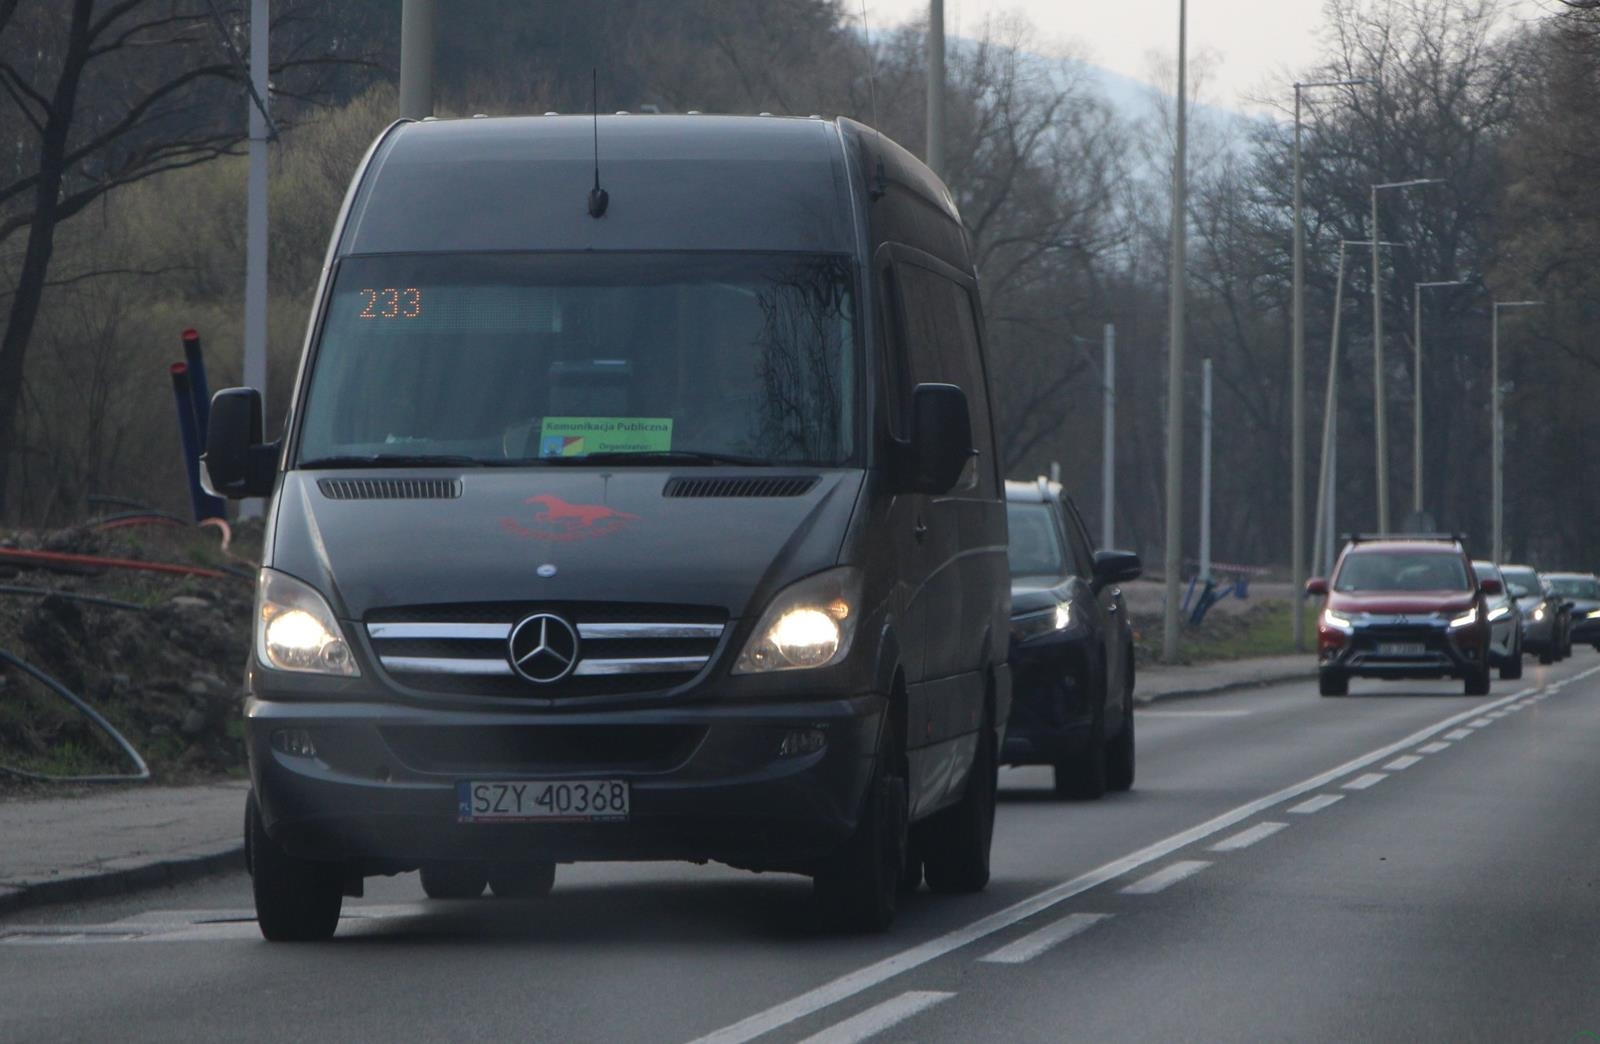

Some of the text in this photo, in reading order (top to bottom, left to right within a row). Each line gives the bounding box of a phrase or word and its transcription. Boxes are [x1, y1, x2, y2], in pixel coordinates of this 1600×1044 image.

[360, 288, 420, 318] 233
[546, 422, 668, 432] Komunikacja Publiczna
[473, 782, 625, 813] SZY 40368
